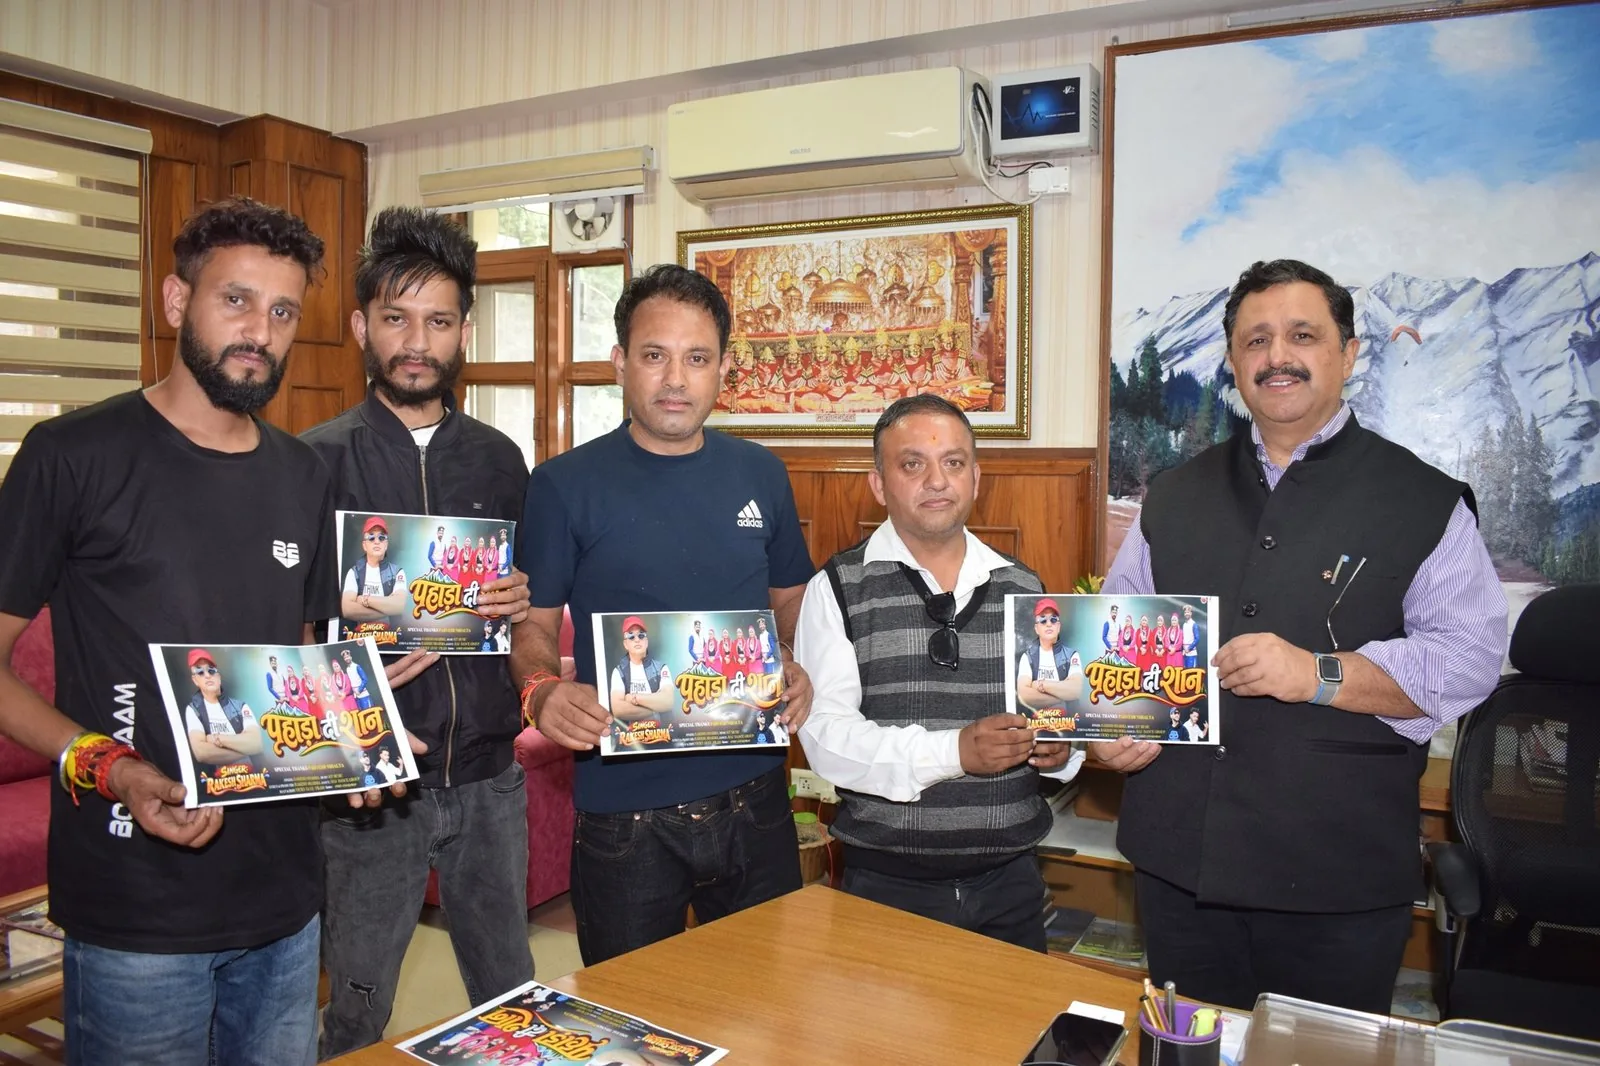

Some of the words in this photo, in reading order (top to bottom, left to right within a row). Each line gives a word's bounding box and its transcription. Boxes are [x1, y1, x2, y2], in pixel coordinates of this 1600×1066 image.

[736, 517, 763, 529] adidas
[1160, 666, 1208, 707] शान
[207, 775, 236, 794] RAKESH
[236, 772, 268, 791] SHARMA
